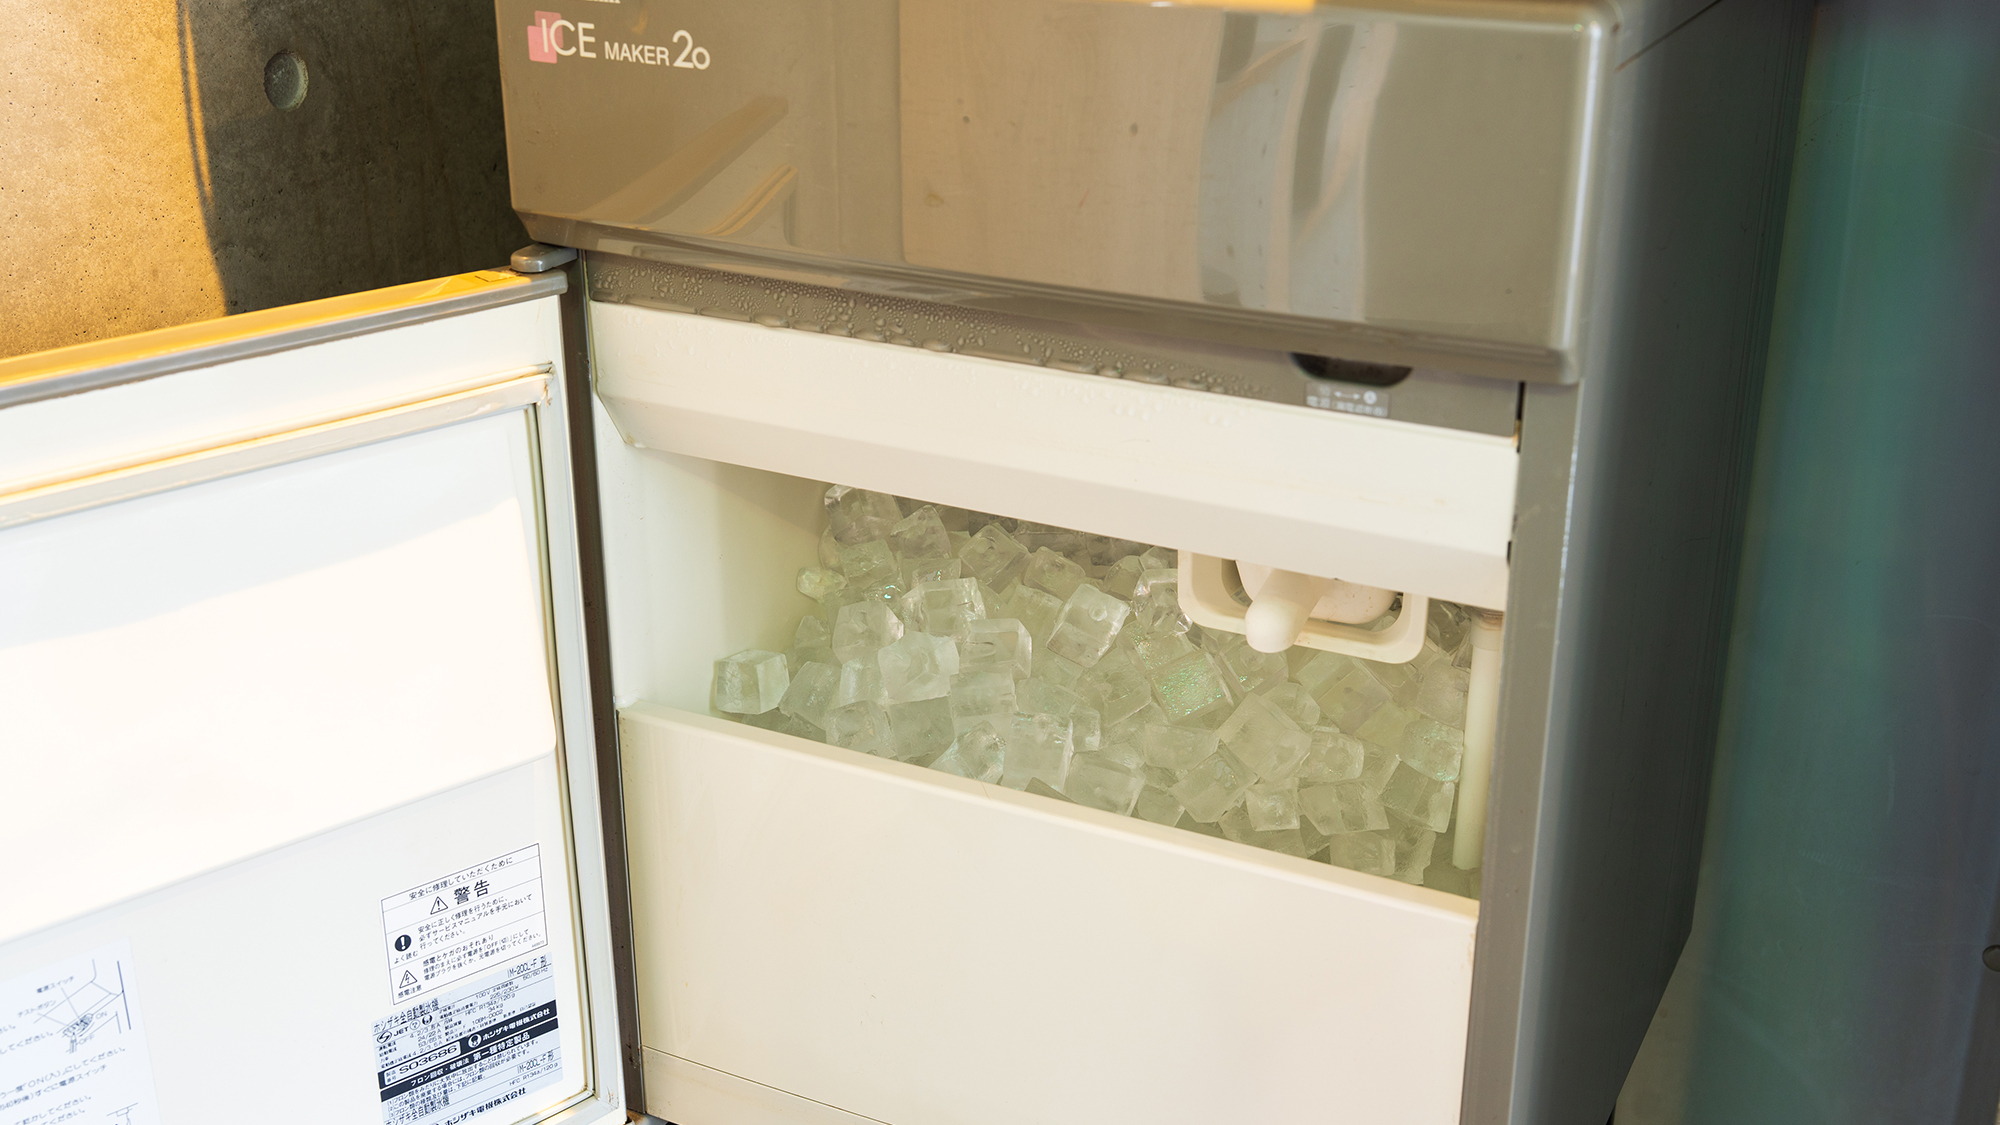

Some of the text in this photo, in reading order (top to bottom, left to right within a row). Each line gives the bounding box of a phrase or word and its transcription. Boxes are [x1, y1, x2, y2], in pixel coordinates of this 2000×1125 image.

[541, 18, 597, 59] ICE
[604, 41, 670, 67] MAKER
[408, 857, 514, 901] 安全に修理していただくために
[453, 879, 490, 906] 警告
[419, 930, 466, 950] 行ってください。
[422, 934, 494, 967] 感電とケガのおそれあり
[394, 951, 418, 964] よく読む
[397, 984, 422, 999] 感電注意
[393, 1026, 409, 1037] JET
[472, 1031, 531, 1062] 第一種特定製品
